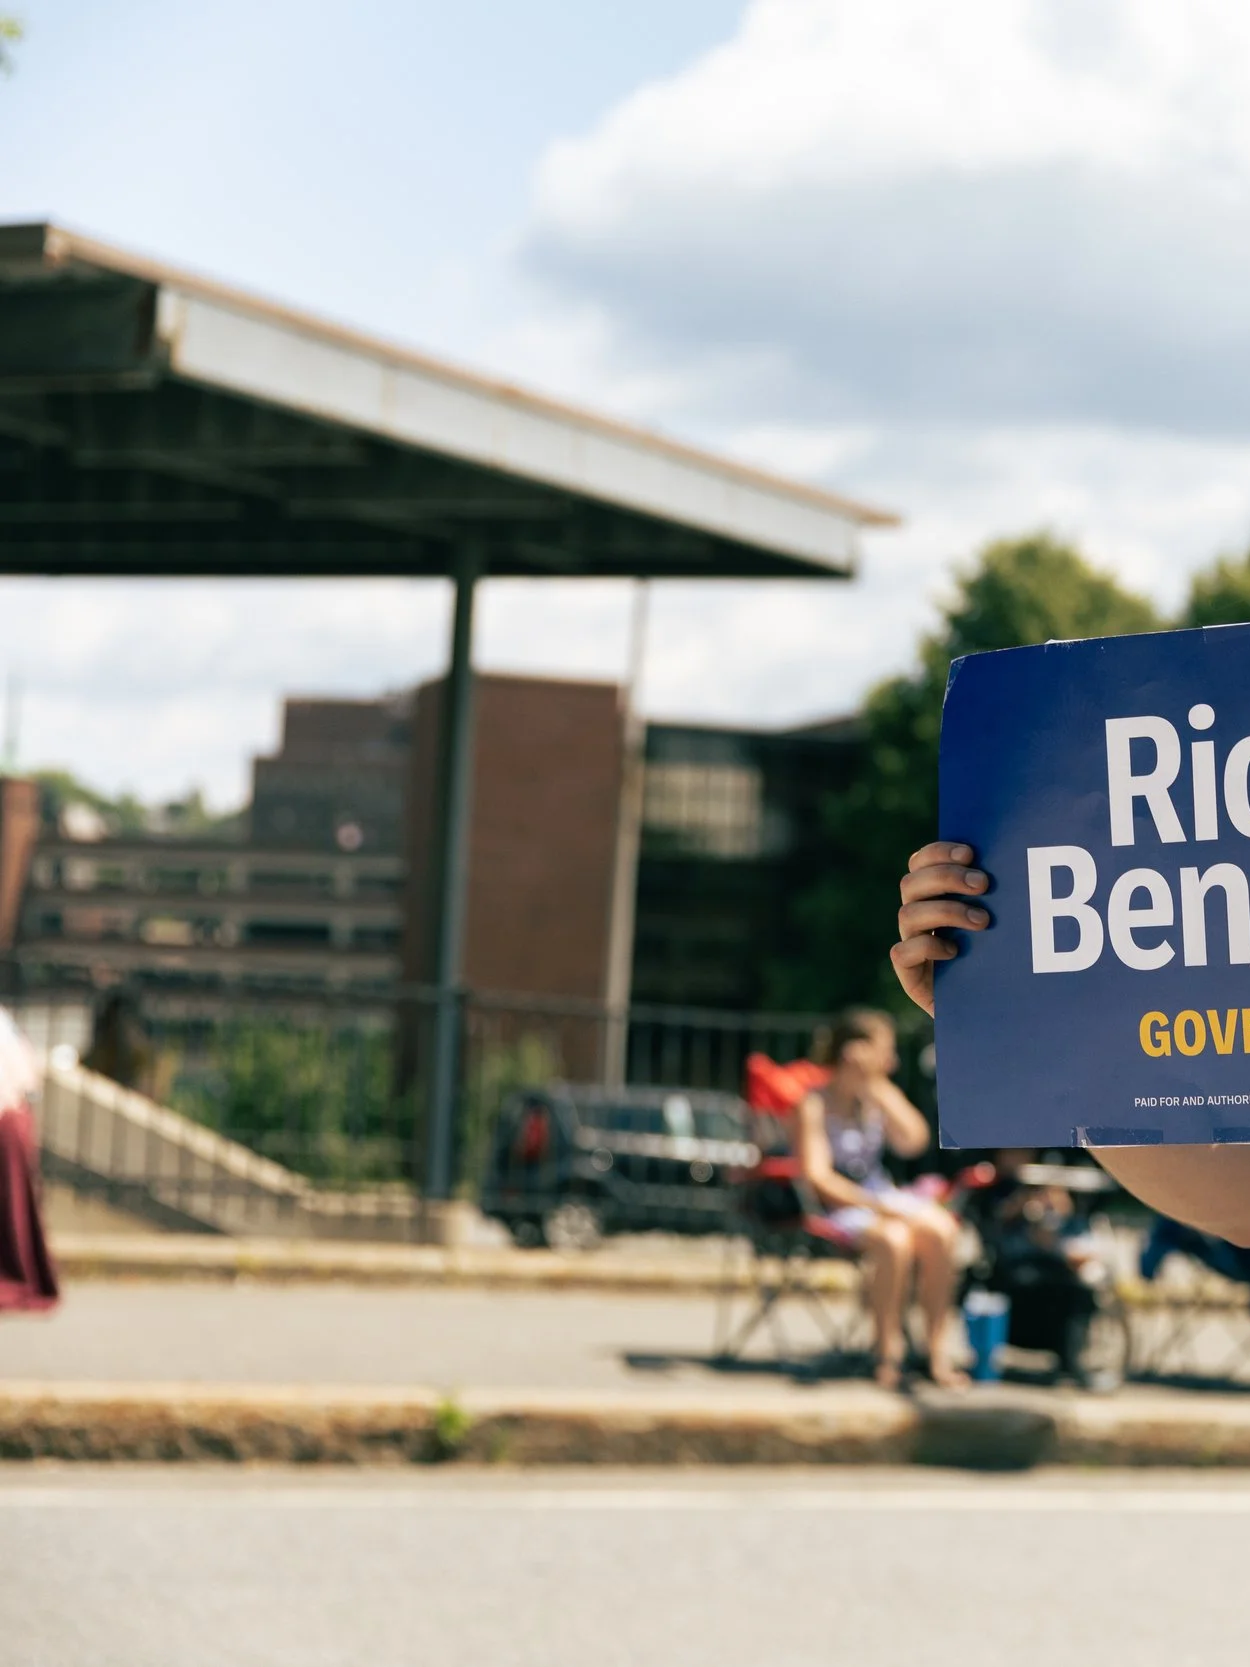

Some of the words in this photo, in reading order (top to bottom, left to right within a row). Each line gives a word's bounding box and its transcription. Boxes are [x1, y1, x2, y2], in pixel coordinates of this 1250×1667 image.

[1134, 1096, 1158, 1108] PAID
[1159, 1096, 1180, 1107] FOR
[1182, 1095, 1205, 1106] AND
